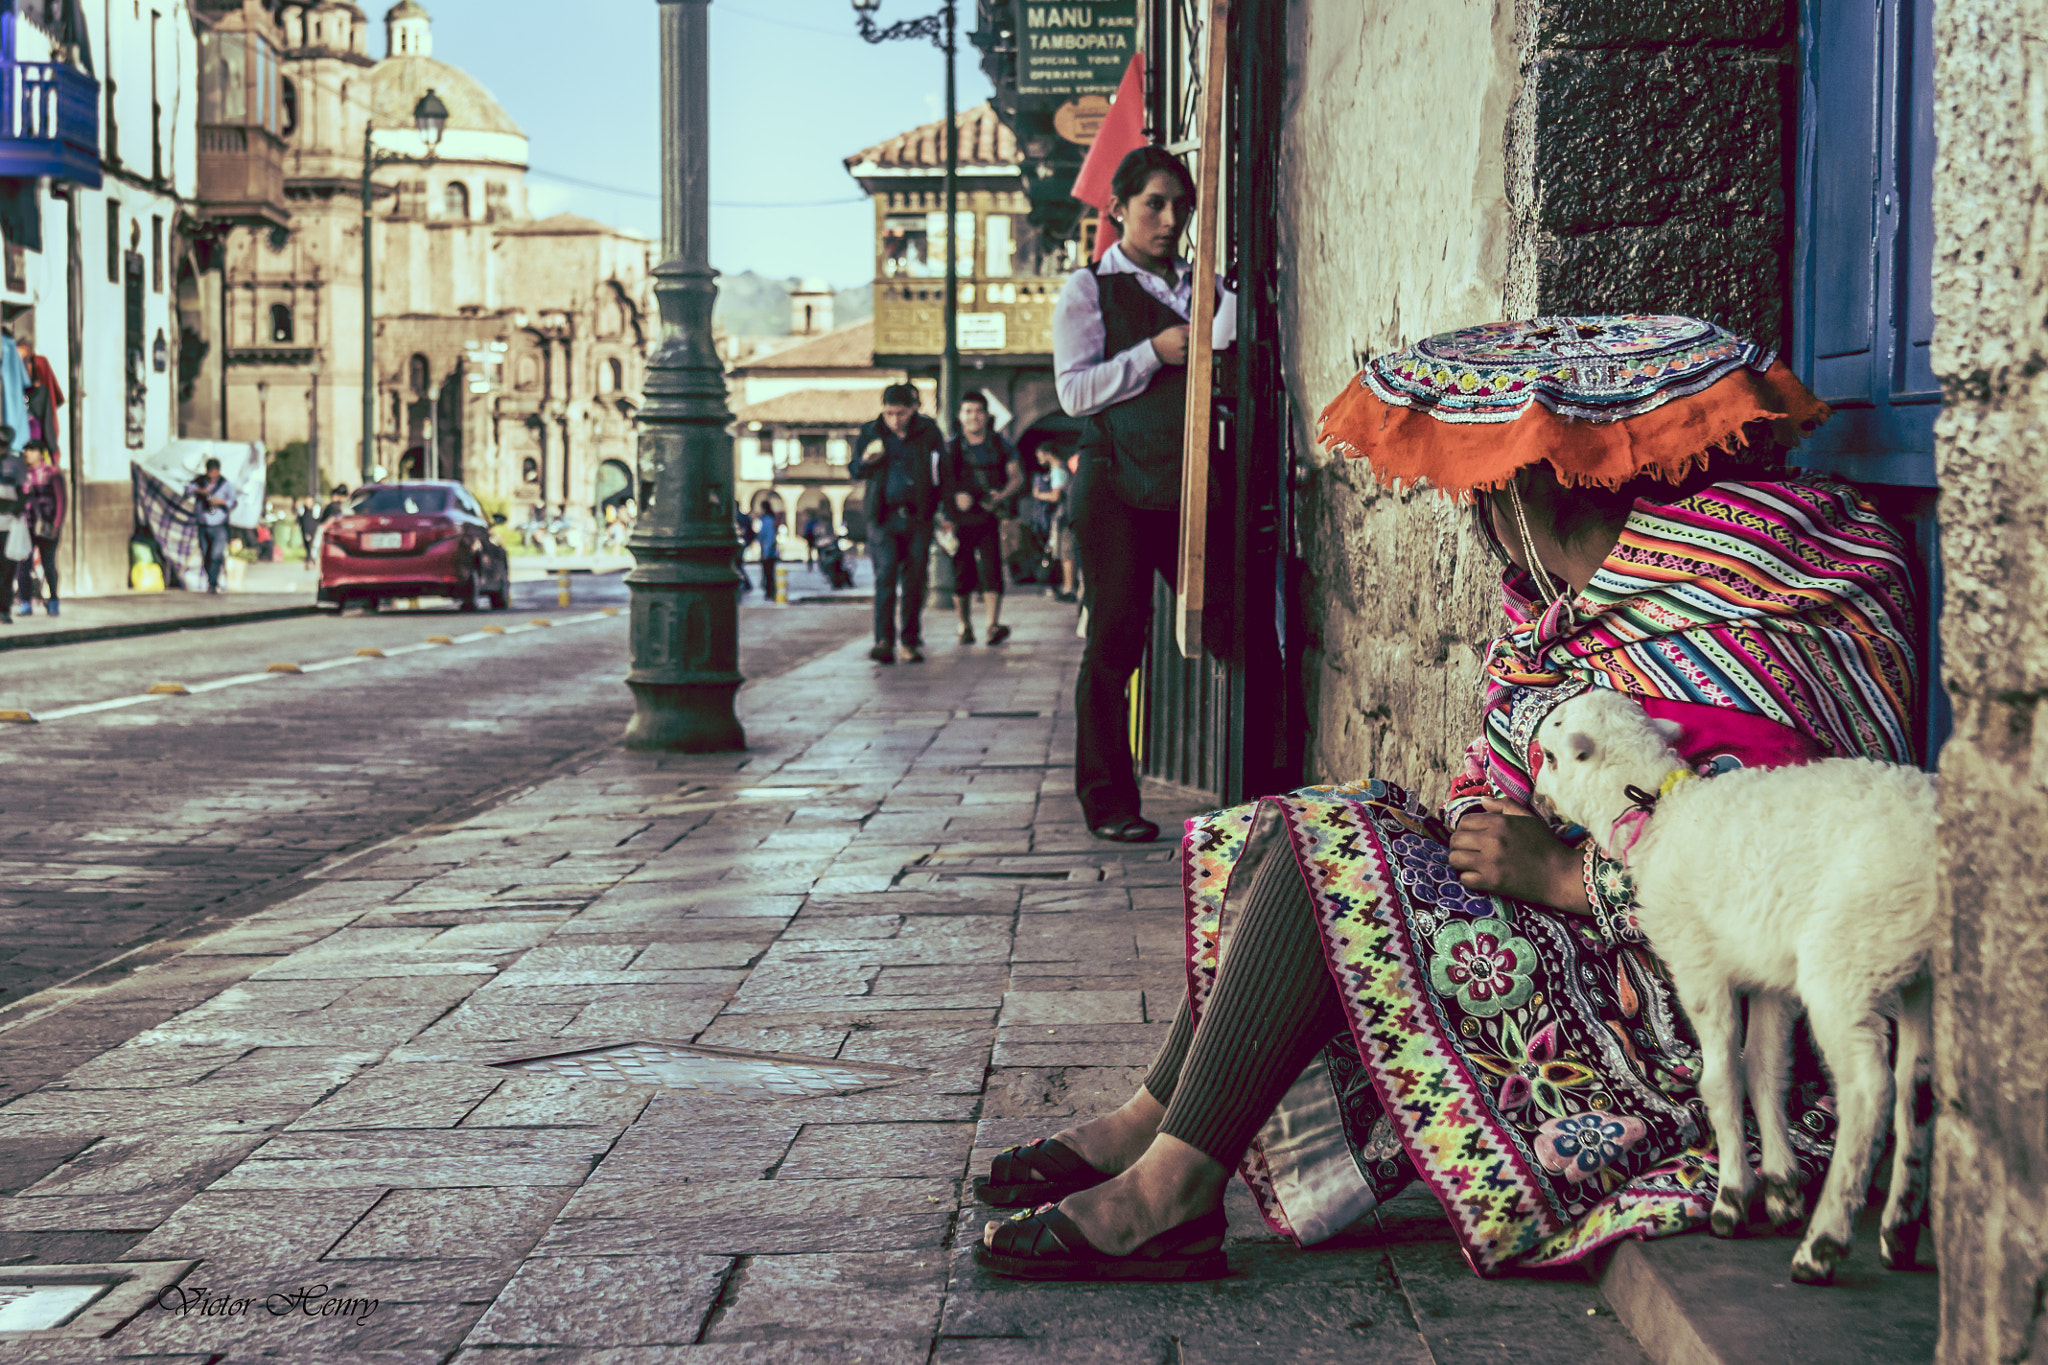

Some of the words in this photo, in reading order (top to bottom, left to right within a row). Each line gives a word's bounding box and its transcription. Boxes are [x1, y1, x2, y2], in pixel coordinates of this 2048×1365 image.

[1027, 7, 1092, 28] MANU
[1098, 17, 1134, 27] PARK
[1029, 34, 1127, 50] TAMBOPATA
[1088, 56, 1120, 65] TOUR
[1030, 71, 1093, 80] OPERATOR
